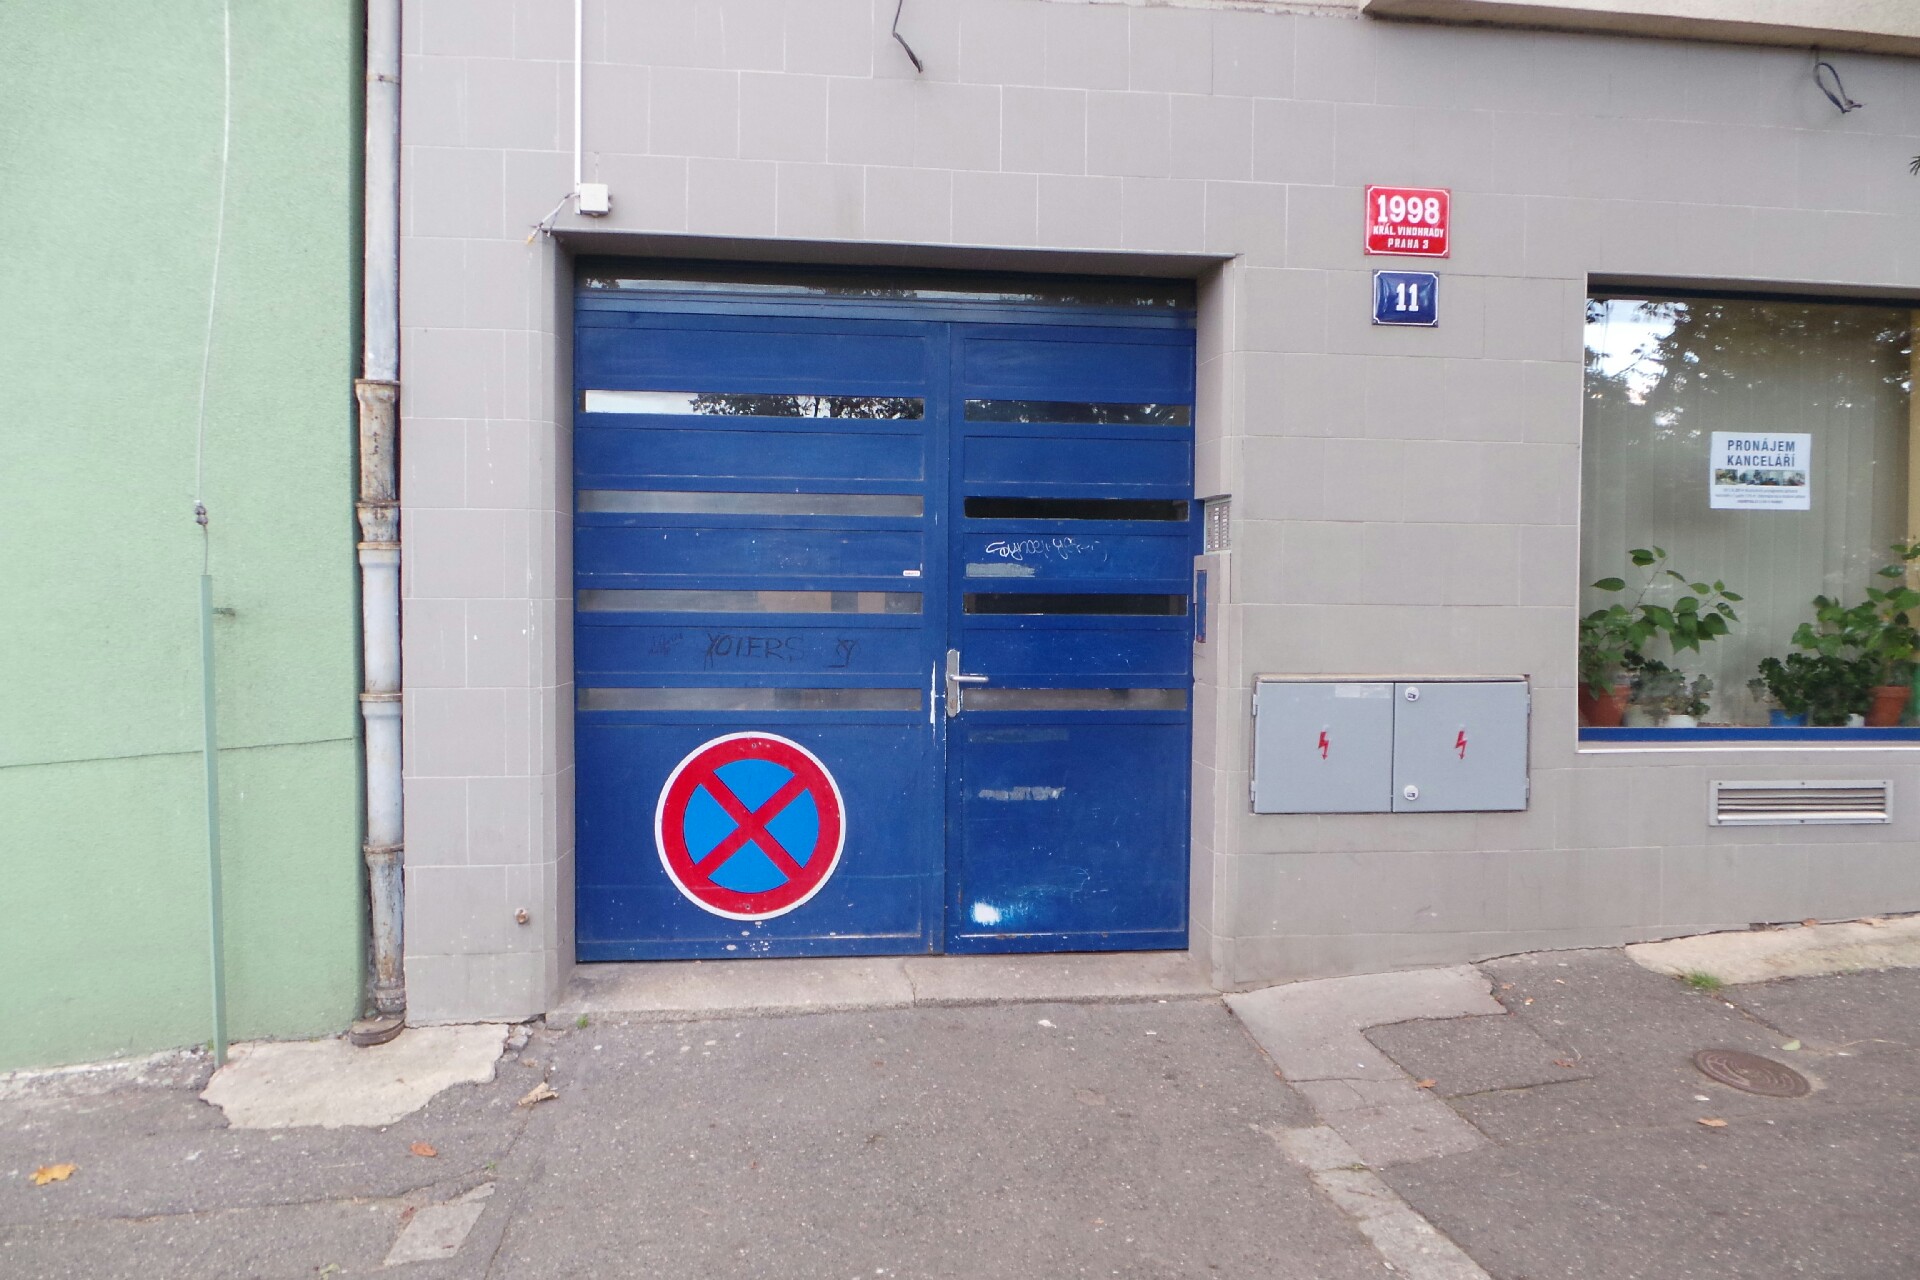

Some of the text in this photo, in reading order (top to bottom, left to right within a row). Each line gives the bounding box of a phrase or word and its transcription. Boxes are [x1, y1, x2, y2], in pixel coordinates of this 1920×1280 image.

[1377, 194, 1440, 225] 1998
[1373, 223, 1444, 238] KRÁL. VINOHRADY
[1387, 238, 1429, 249] PRAHA 3
[1395, 282, 1419, 312] 11
[1727, 438, 1796, 452] PRONÁJEM
[1727, 453, 1796, 467] KANCELÁŘÍ
